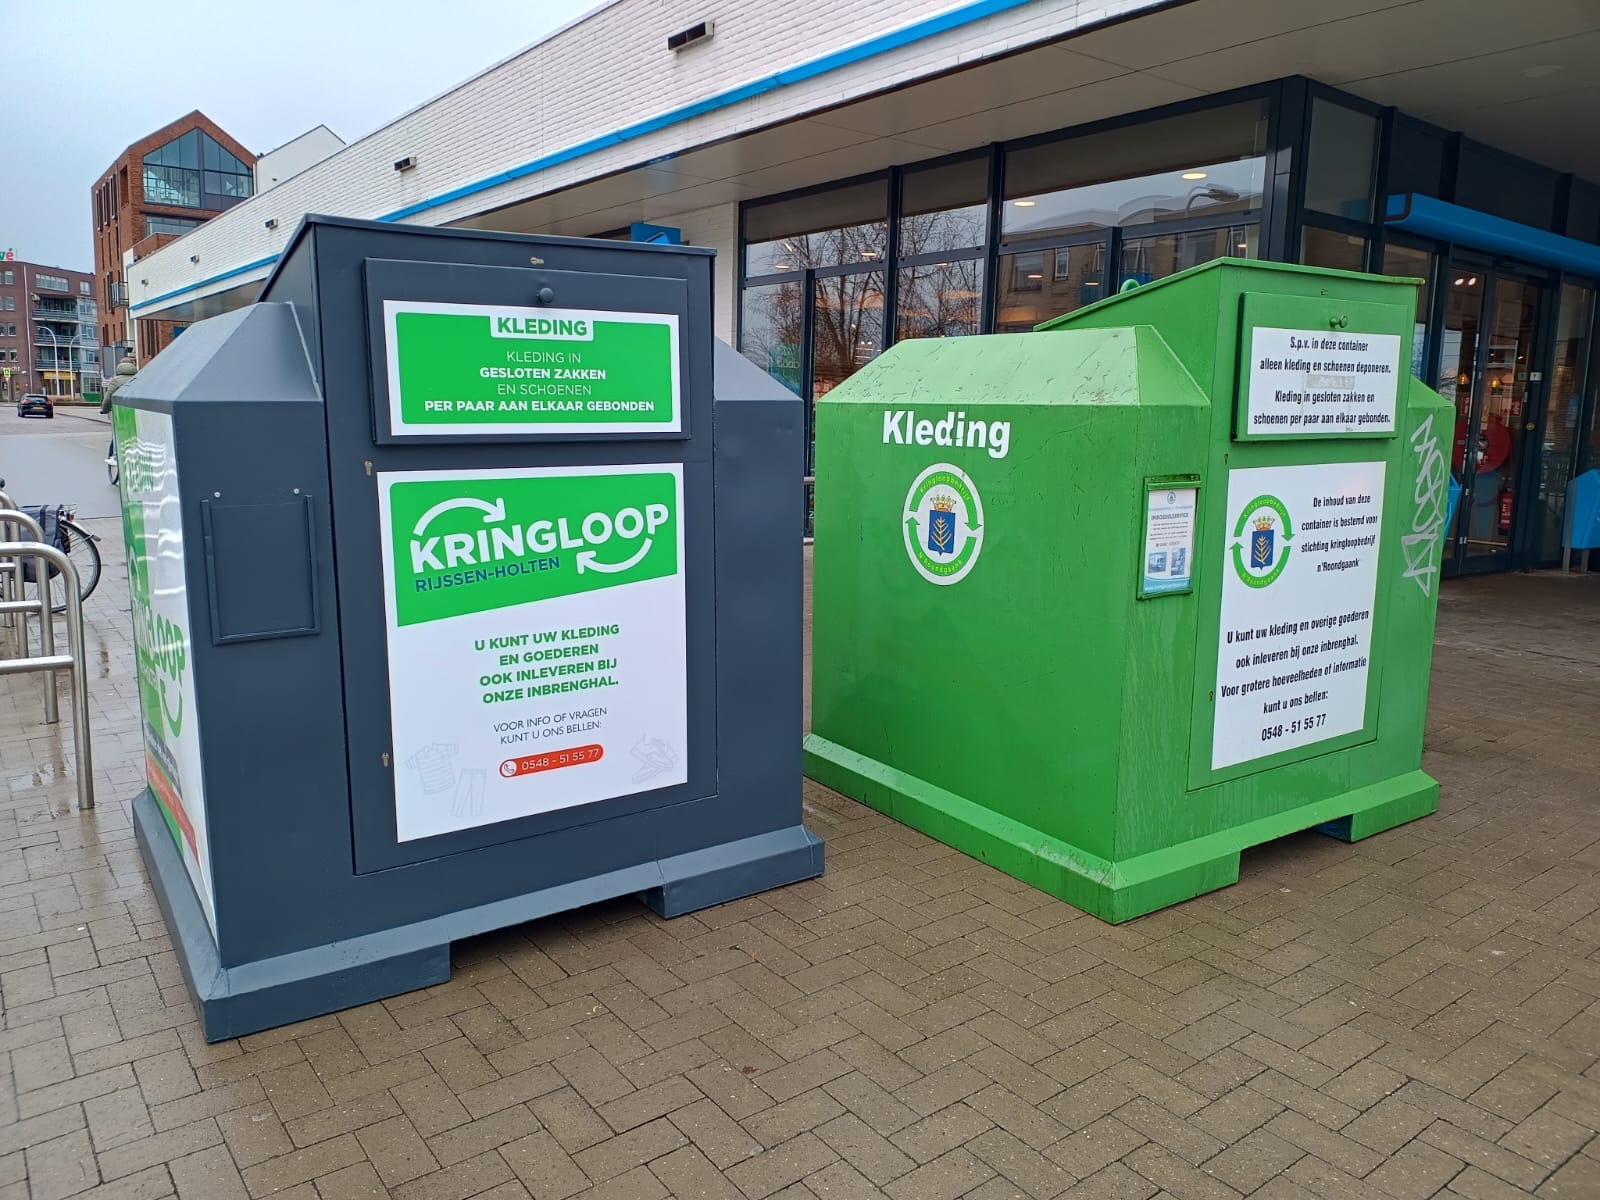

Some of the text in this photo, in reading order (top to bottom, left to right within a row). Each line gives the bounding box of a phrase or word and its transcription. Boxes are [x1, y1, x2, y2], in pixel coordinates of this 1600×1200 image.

[497, 317, 587, 336] KLEDING
[1290, 336, 1368, 352] S.p.v. in deze container
[506, 352, 581, 363] KLEDING IN
[1260, 358, 1391, 375] alleen kleding en schoenen deponeren.
[480, 368, 606, 380] GESLOTEN ZAKKEN
[498, 384, 591, 395] EN SCHOENEN
[1275, 390, 1375, 405] Kleding in gesloten zakken en
[425, 401, 654, 411] PER PAAR AAN ELKAAR GEBONDEN
[1254, 412, 1390, 426] schoenen per paar aan elkaar gebonden.
[882, 411, 1010, 459] Kleding
[1313, 494, 1371, 508] De inhoud van deze
[1301, 516, 1378, 531] container is bestemd voor
[410, 503, 669, 575] KRINGLOOP
[1301, 535, 1376, 553] stichting kringloopbedrijf
[415, 557, 560, 592] RIJSSEN-HOLTEN
[474, 624, 619, 651] U KUNT UW KLEDING
[1227, 610, 1369, 644] U kunt uw kleding en overige goederen
[500, 644, 599, 666] EN GOEDEREN
[1236, 635, 1359, 669] ook inleveren bij onze inbrenghal.
[479, 658, 617, 687] OOK INLEVEREN BIJ
[1221, 656, 1366, 698] Voor grotere hoeveelheden of informatie
[482, 676, 619, 704] ONZE INBRENGHAL.
[1263, 690, 1328, 714] kunt u ons bellen:
[493, 707, 607, 733] VOOR INFO OF VRAGEN
[1261, 725, 1282, 741] 0548
[1291, 720, 1301, 734] 51
[1304, 717, 1313, 730] 55
[1316, 713, 1326, 726] 77
[500, 721, 602, 744] KUNT U ONS BELLEN:
[521, 757, 549, 771] 0548
[559, 753, 569, 764] 51
[572, 750, 585, 761] 55
[587, 748, 599, 759] 77
